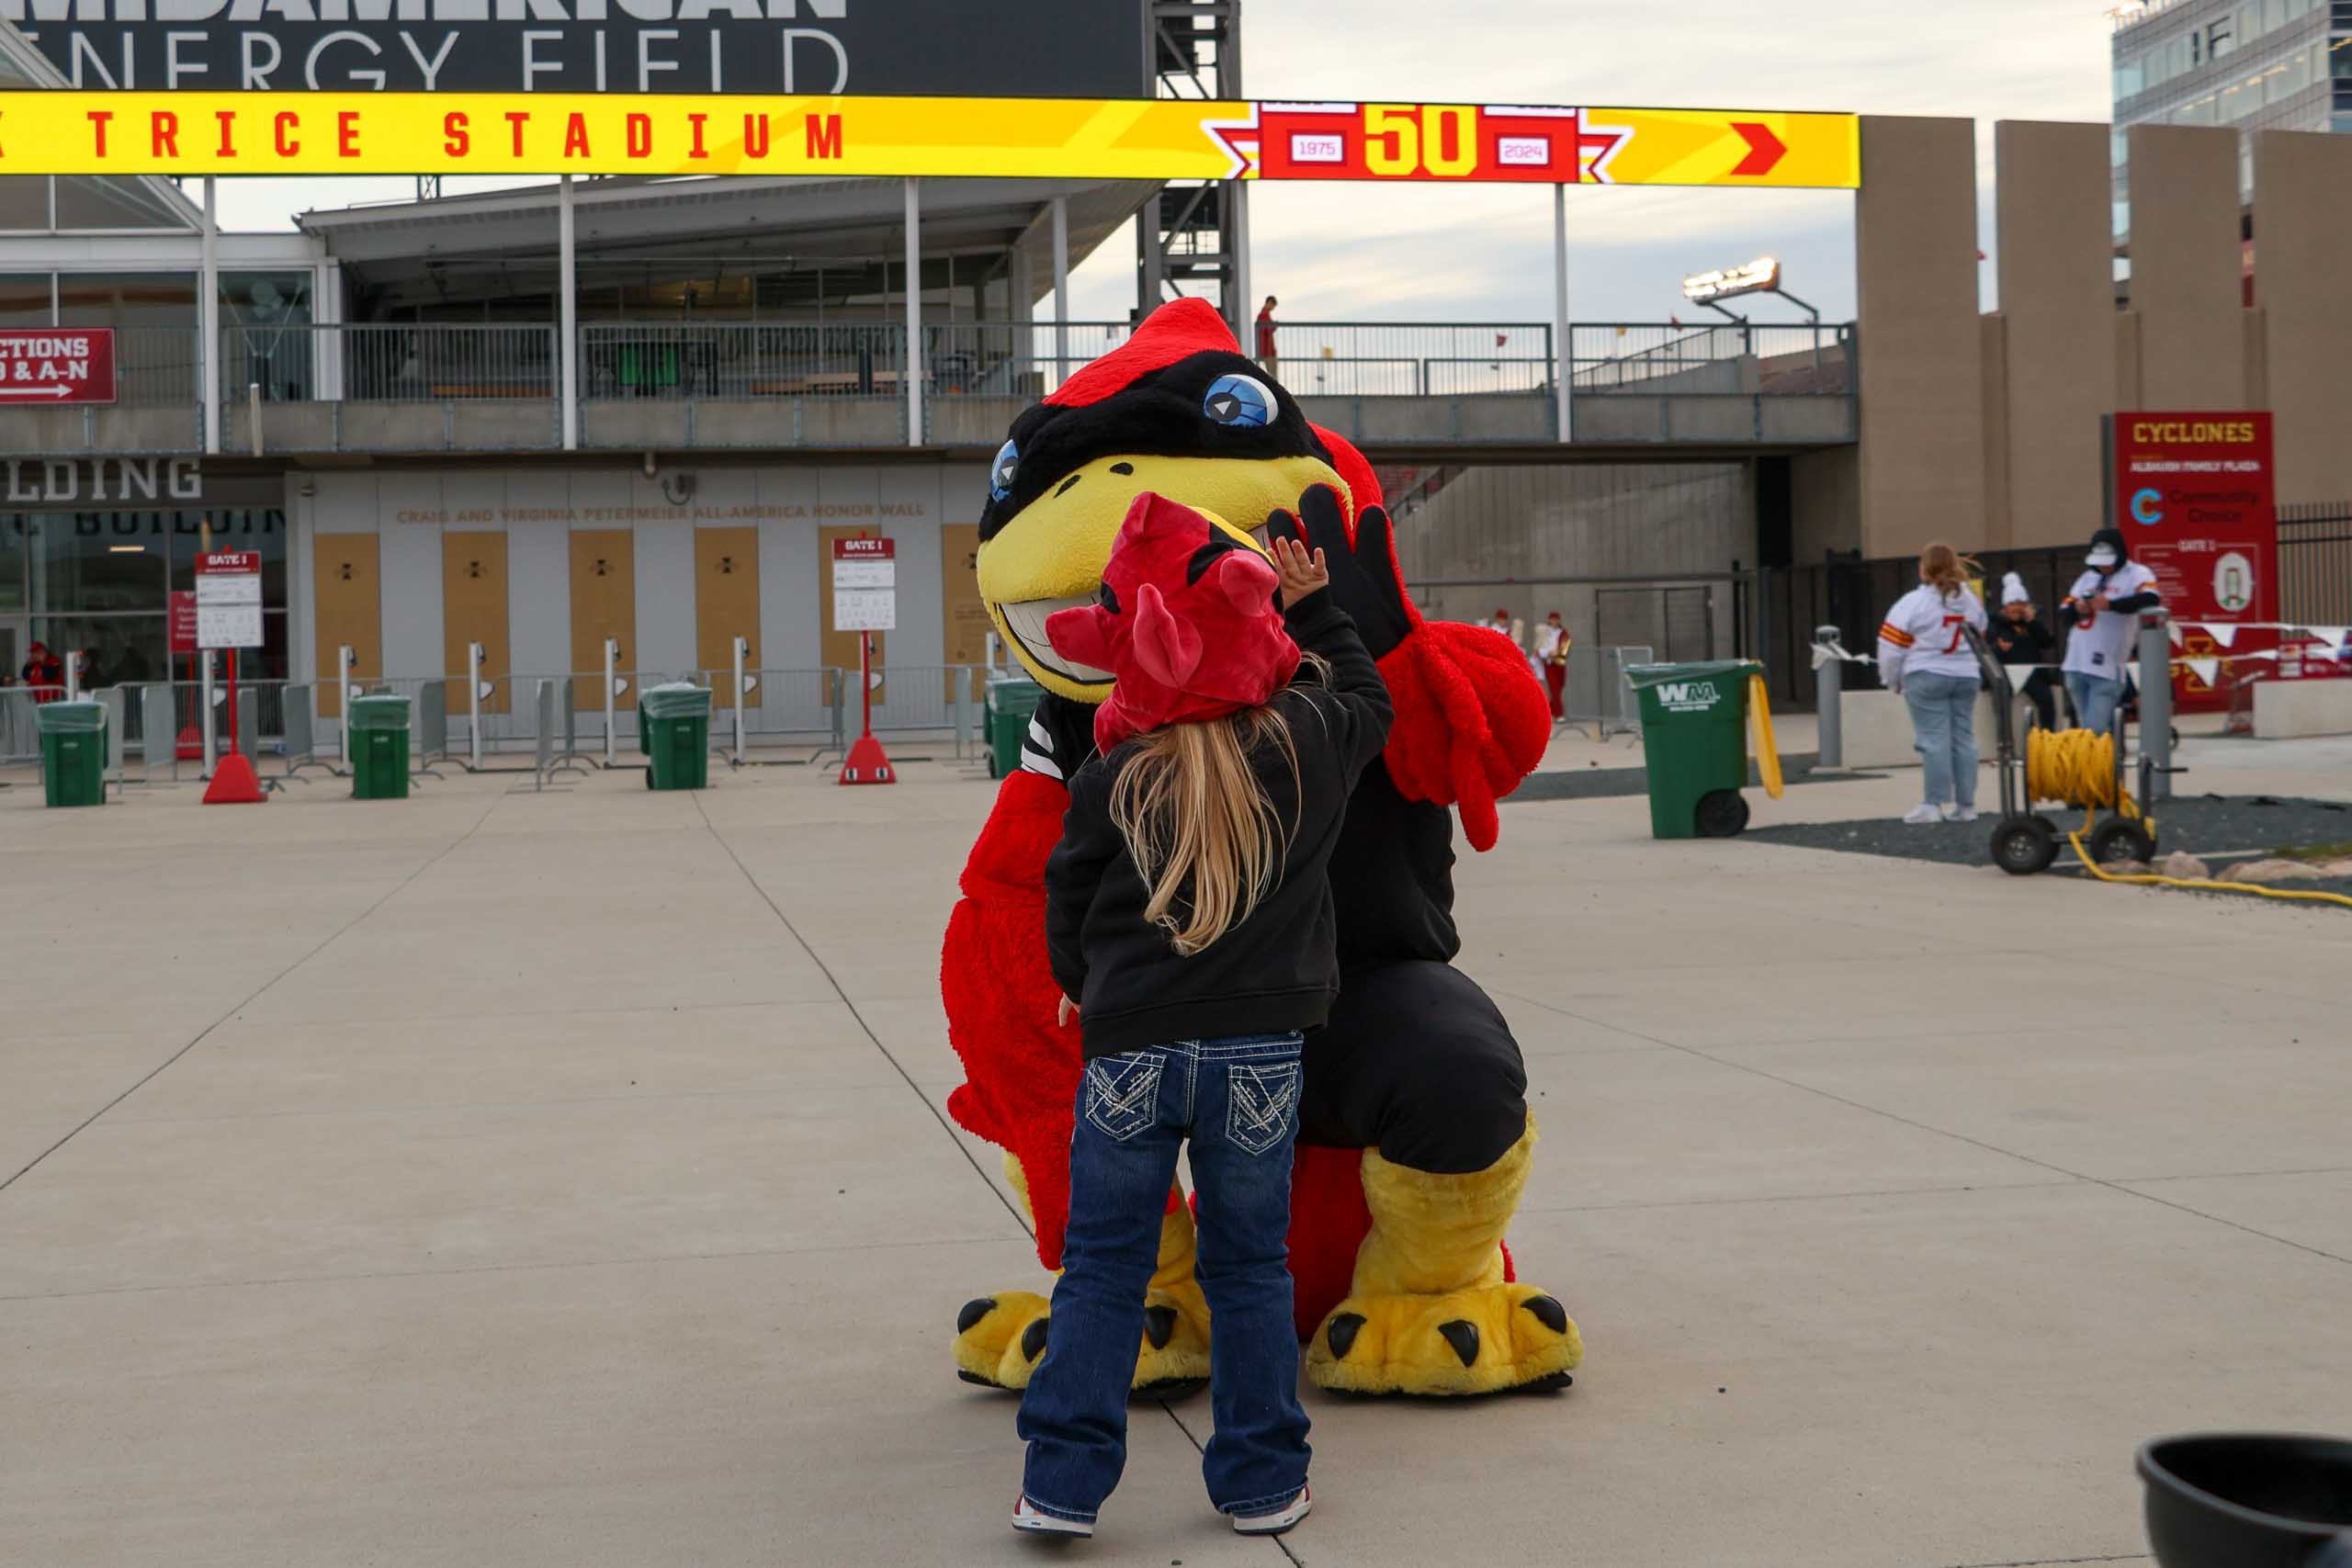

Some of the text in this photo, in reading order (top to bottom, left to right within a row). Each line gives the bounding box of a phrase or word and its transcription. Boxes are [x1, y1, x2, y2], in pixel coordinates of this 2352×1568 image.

[22, 30, 459, 90] NERGY
[87, 111, 842, 159] TRICE STADIUM
[1365, 103, 1478, 176] 50
[1299, 141, 1336, 156] 1975
[1504, 144, 1544, 159] 2024
[15, 361, 33, 380] &
[39, 359, 88, 380] A-N
[2132, 423, 2256, 443] CYCLONES
[456, 508, 493, 523] AND
[845, 540, 876, 550] GATE
[208, 555, 240, 565] GATE
[1942, 615, 1966, 654] 7
[1656, 682, 1716, 703] WM
